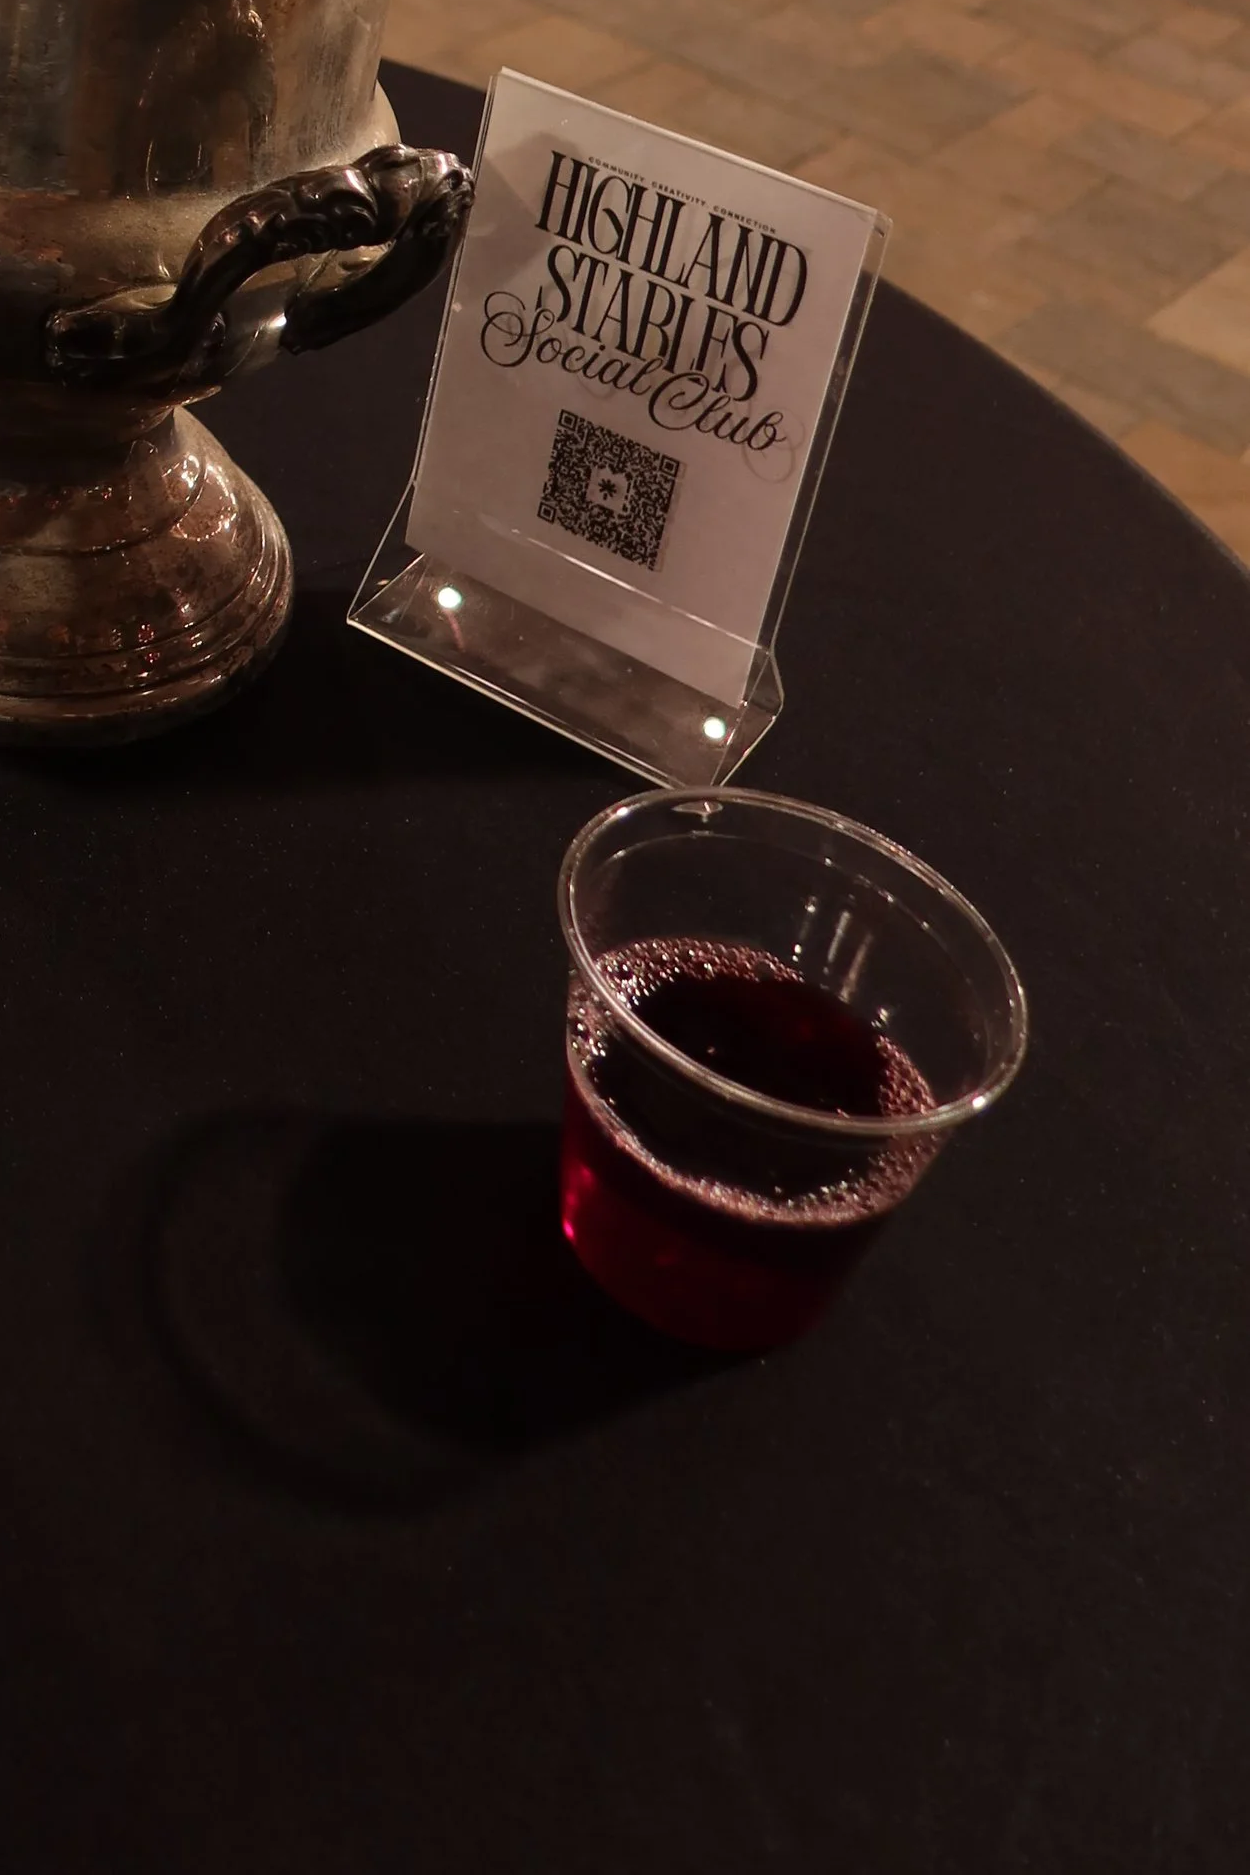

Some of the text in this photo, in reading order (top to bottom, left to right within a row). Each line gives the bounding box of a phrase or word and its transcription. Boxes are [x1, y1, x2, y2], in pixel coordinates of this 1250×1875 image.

[534, 150, 808, 327] HIGHLAND
[713, 204, 777, 235] CONNECTION
[480, 285, 787, 452] Social Club
[547, 244, 770, 402] STABLES
